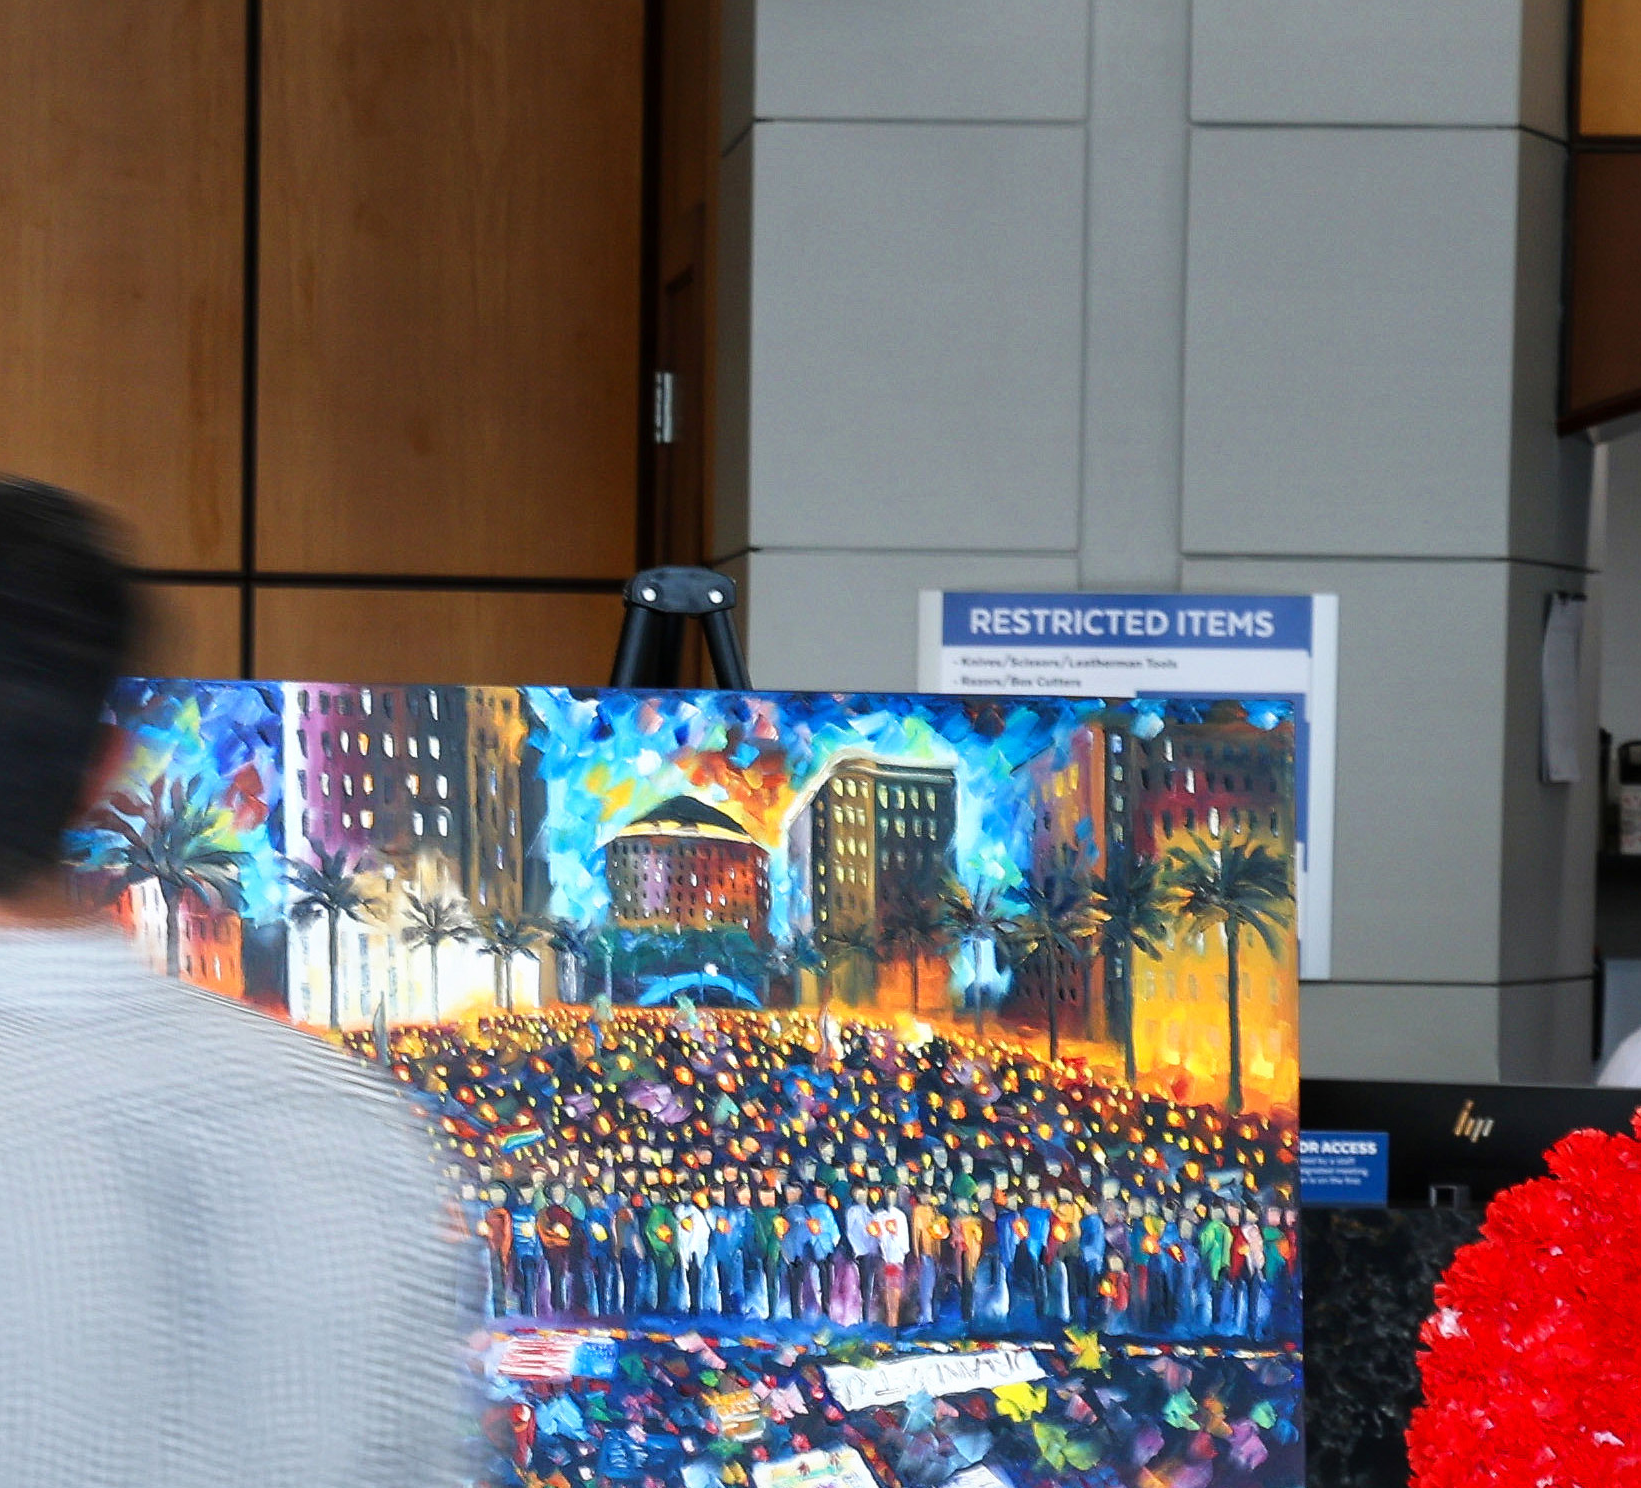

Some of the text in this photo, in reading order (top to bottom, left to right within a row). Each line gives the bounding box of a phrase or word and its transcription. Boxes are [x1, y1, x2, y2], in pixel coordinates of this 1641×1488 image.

[969, 608, 1275, 638] RESTRICTED ITEMS
[1145, 656, 1178, 670] Tools
[1036, 675, 1082, 688] Cutters
[1321, 1141, 1378, 1155] ACCESS
